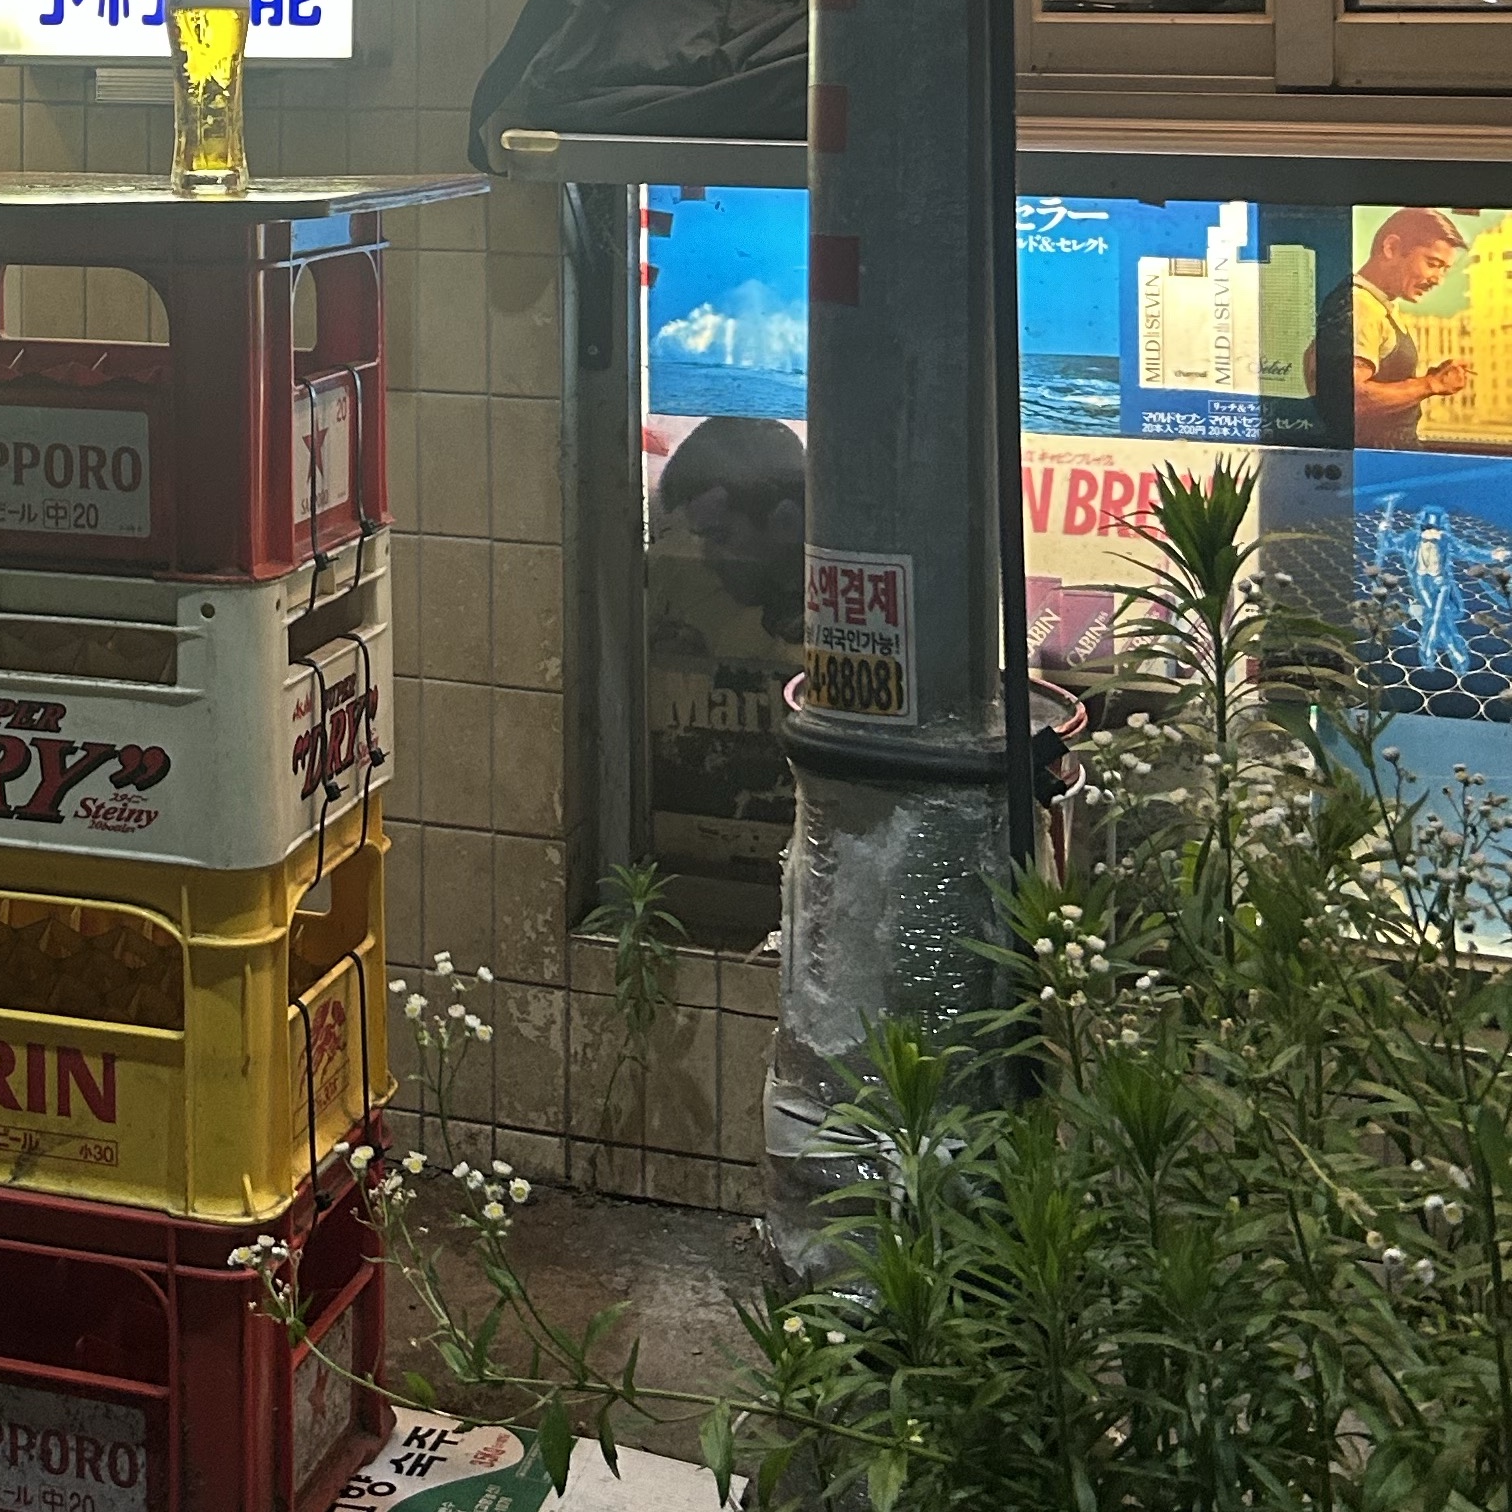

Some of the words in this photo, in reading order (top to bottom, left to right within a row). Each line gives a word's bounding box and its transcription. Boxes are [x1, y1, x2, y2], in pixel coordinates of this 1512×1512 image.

[1145, 273, 1161, 330] SEVEN
[1145, 339, 1161, 384] MILD
[1214, 334, 1232, 385] MILD
[1256, 356, 1292, 377] Select
[72, 503, 99, 530] 20
[1065, 617, 1107, 668] CABIN
[74, 795, 160, 829] Steiny
